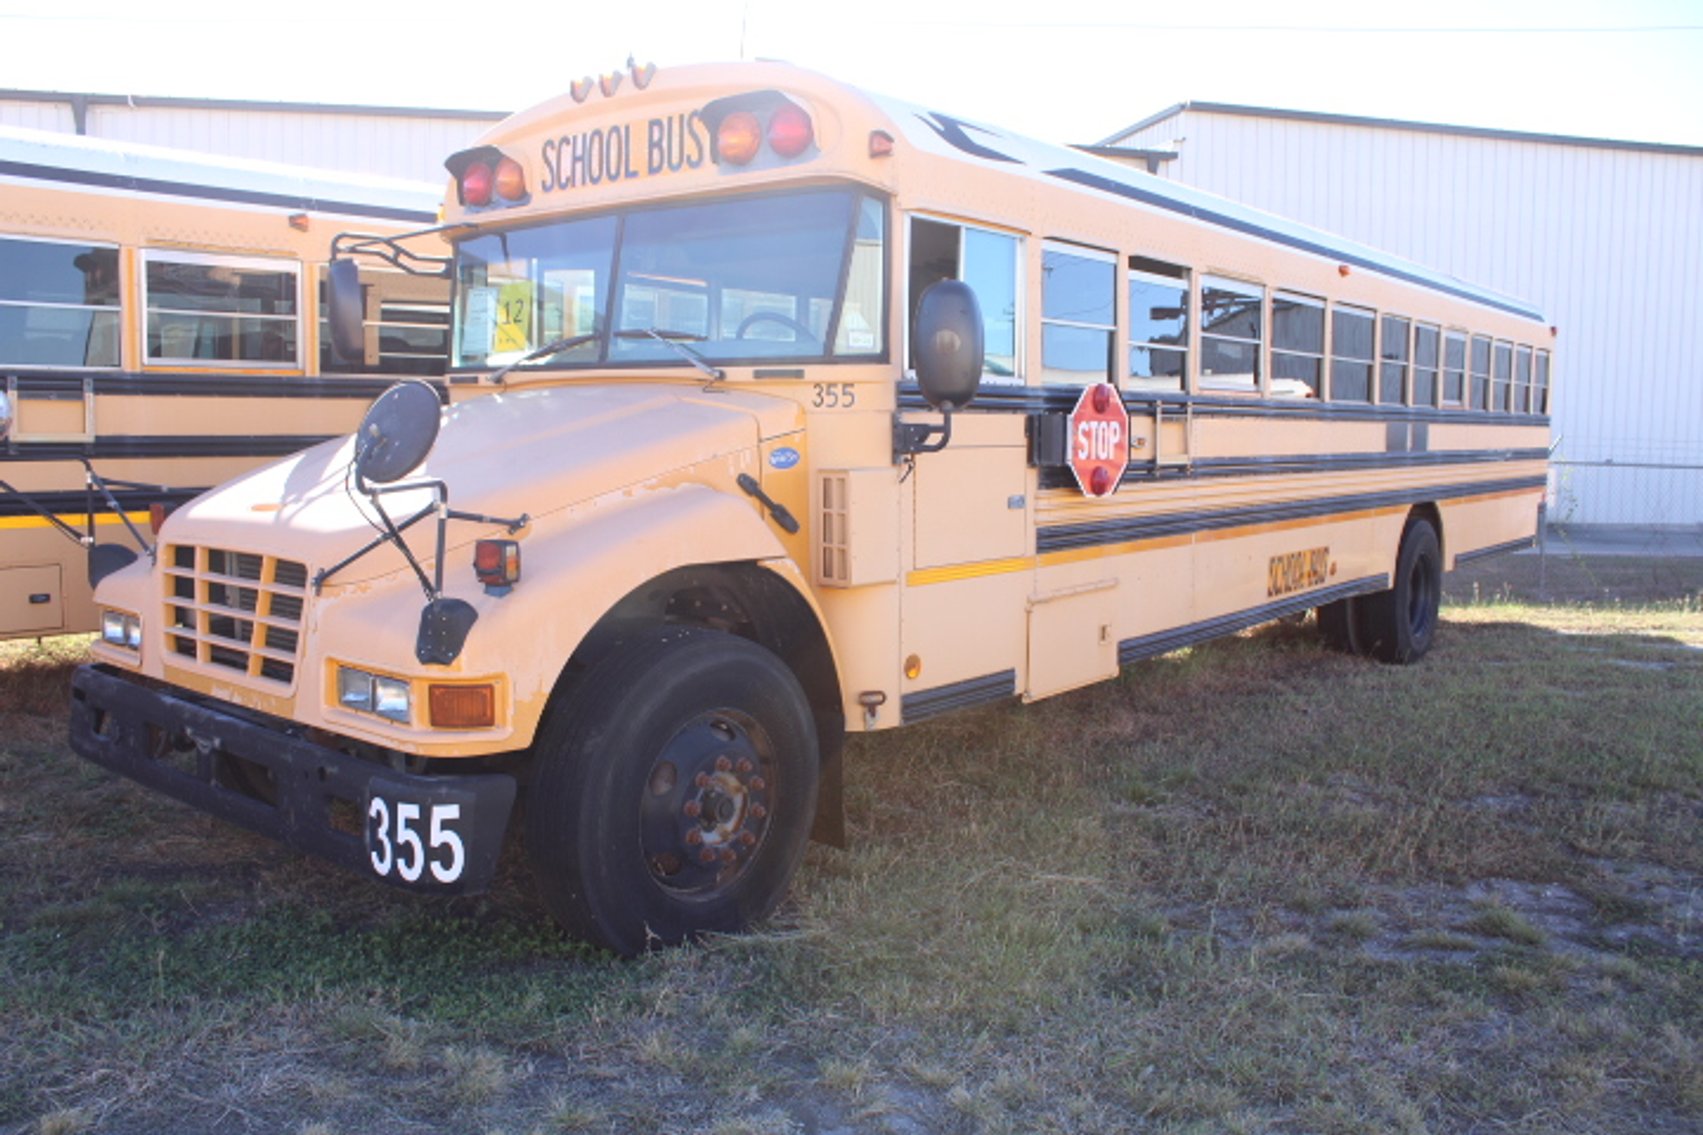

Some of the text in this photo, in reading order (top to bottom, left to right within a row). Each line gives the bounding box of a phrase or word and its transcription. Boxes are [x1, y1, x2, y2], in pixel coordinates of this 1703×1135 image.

[541, 109, 704, 193] SCHOOL BUS
[502, 298, 524, 325] 12
[812, 383, 855, 408] 355
[1078, 421, 1120, 460] STOP
[369, 797, 465, 883] 355
